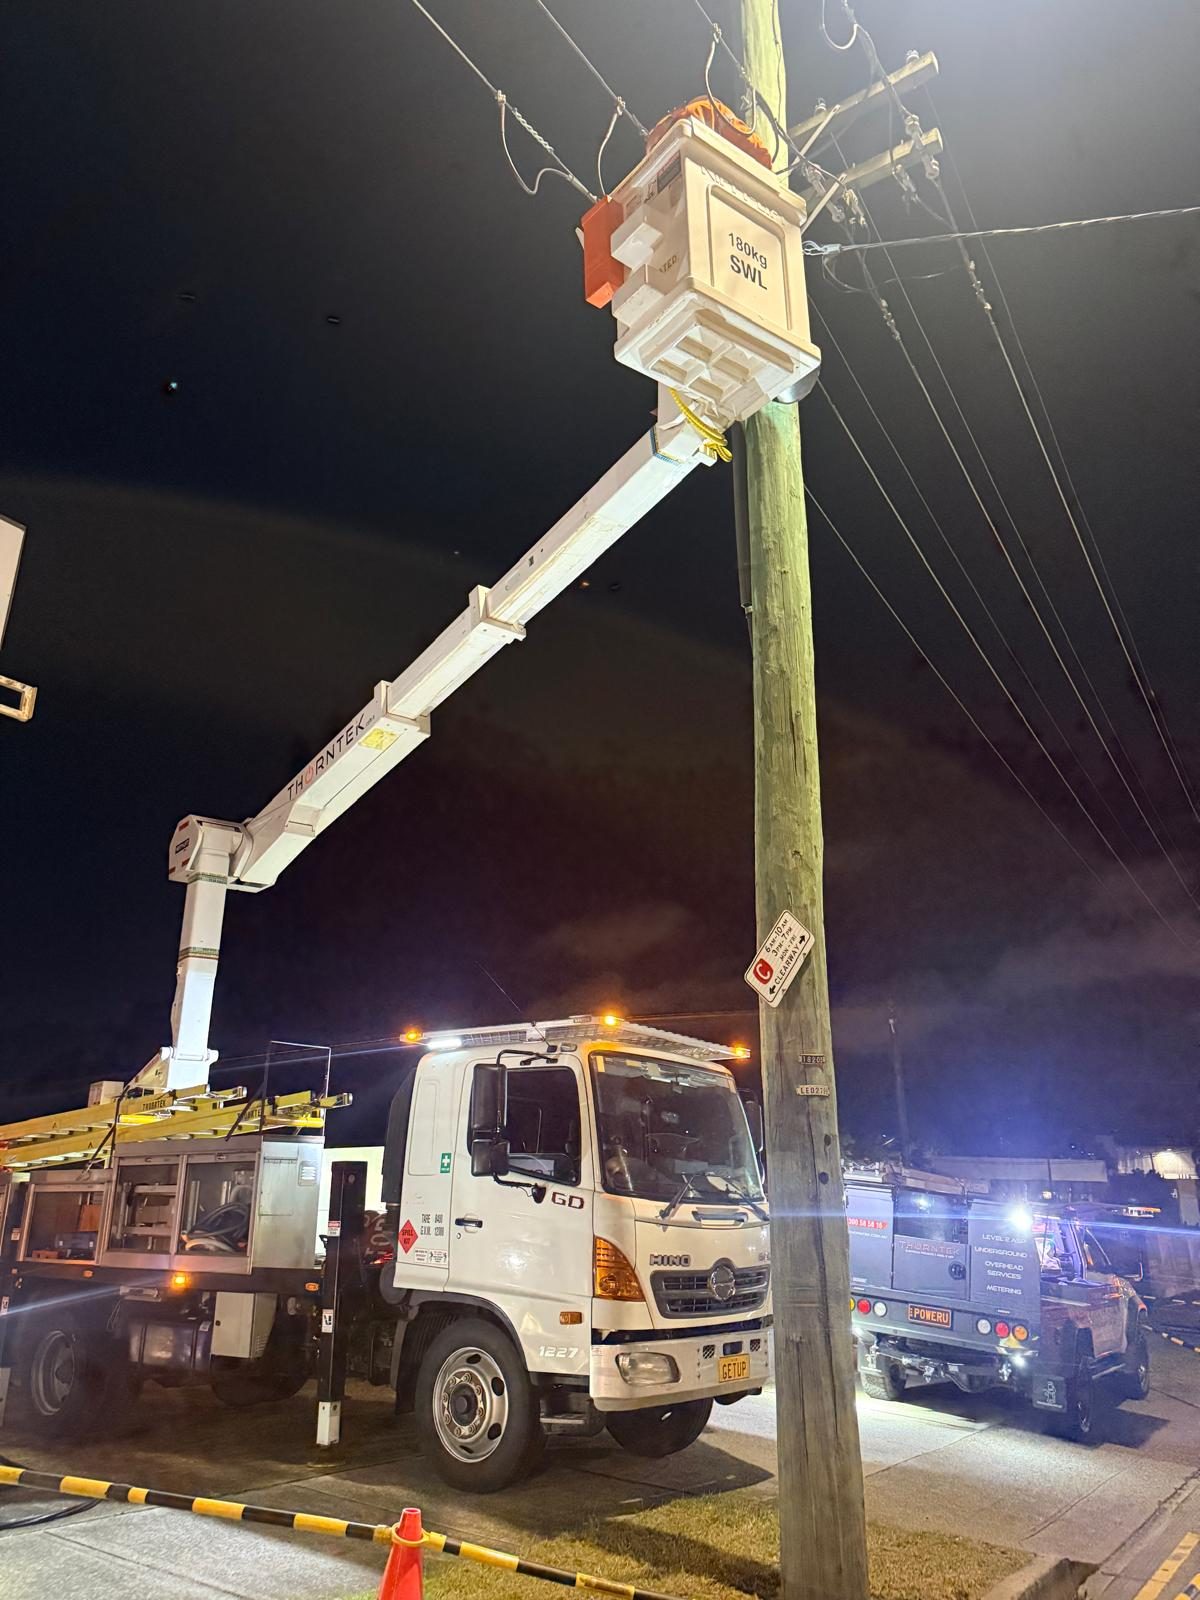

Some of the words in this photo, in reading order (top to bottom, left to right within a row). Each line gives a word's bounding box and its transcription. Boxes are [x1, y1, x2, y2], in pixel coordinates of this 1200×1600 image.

[728, 232, 768, 270] 180kg
[730, 254, 768, 290] SWL
[287, 712, 365, 801] THORNTEK
[774, 944, 800, 985] CLEARWAY
[551, 1191, 585, 1210] GD
[982, 1233, 1004, 1242] LEVEL
[974, 1246, 1028, 1258] UNDERGROUND
[650, 1254, 691, 1267] HINO
[984, 1260, 1024, 1271] OVERHEAD
[986, 1269, 1022, 1280] SERVICES
[986, 1284, 1022, 1295] METERING
[913, 1307, 949, 1324] POWERU
[539, 1345, 579, 1359] 1227
[722, 1361, 747, 1380] GETUP
